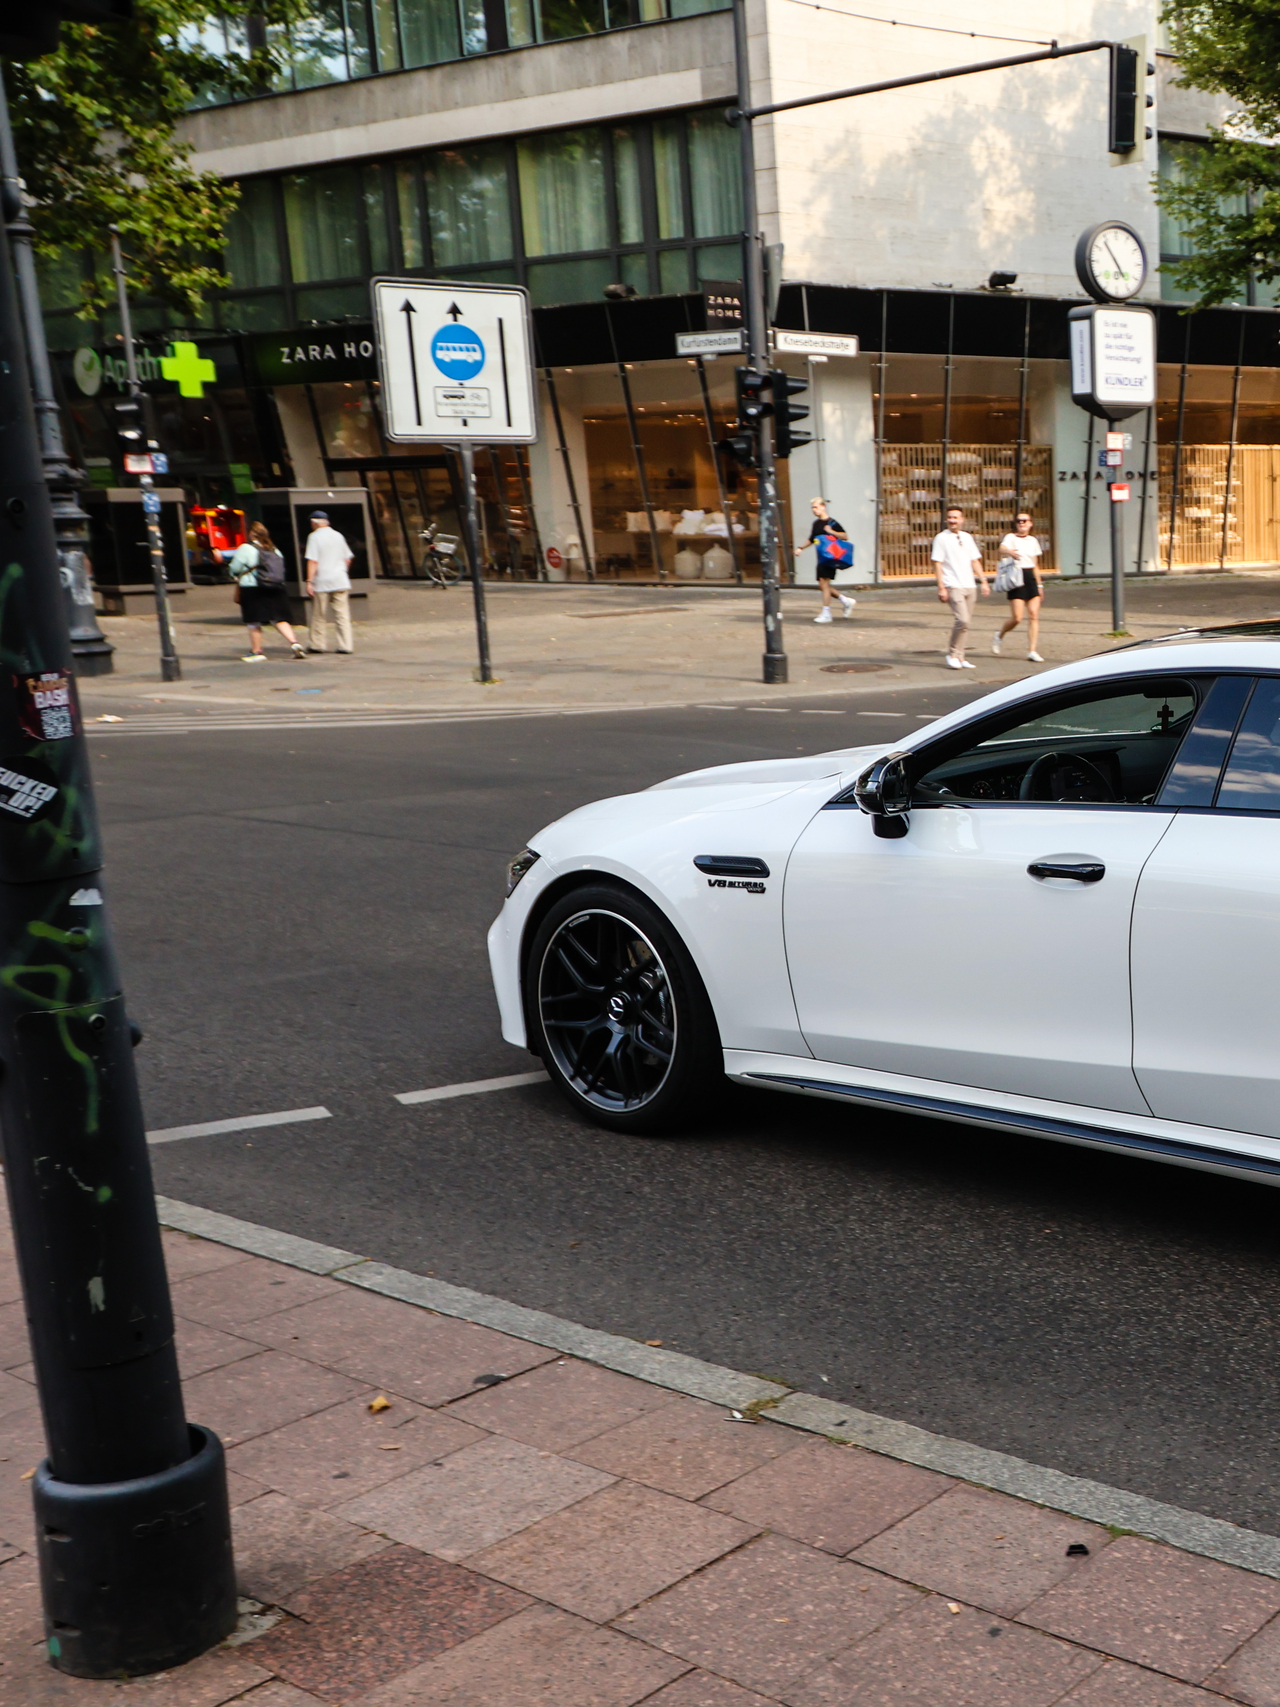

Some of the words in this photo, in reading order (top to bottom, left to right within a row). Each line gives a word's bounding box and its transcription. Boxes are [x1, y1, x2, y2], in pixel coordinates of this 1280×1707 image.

[708, 296, 740, 305] ZARA
[707, 309, 742, 318] HOME
[680, 336, 739, 349] Kurfürstendamm
[280, 344, 337, 363] ZARA
[343, 341, 373, 358] HO
[34, 689, 70, 708] BASH
[8, 791, 45, 814] UP!
[707, 879, 727, 888] V8
